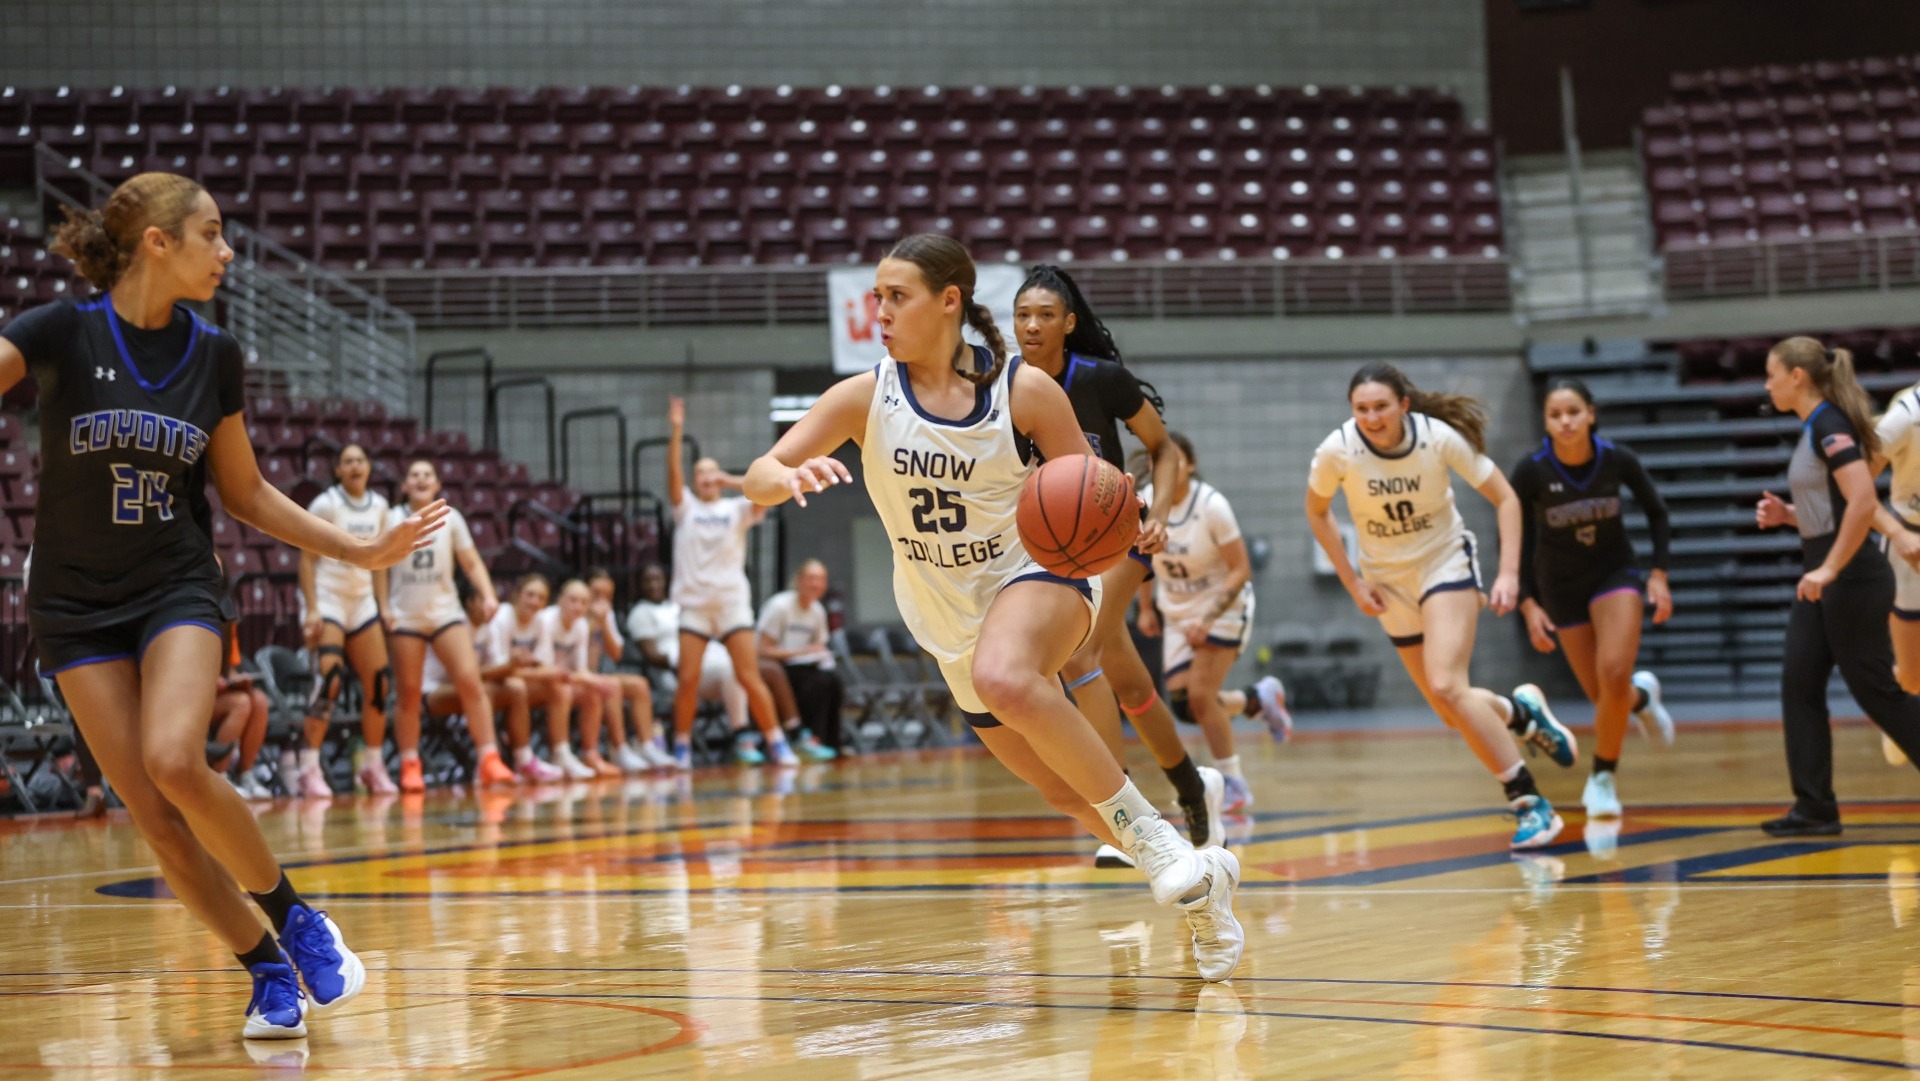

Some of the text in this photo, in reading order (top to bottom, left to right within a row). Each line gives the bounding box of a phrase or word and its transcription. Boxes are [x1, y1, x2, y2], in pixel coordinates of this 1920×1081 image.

[893, 447, 976, 482] SNOW
[109, 463, 175, 524] 24
[1367, 474, 1421, 497] SNOW
[908, 486, 967, 534] 25
